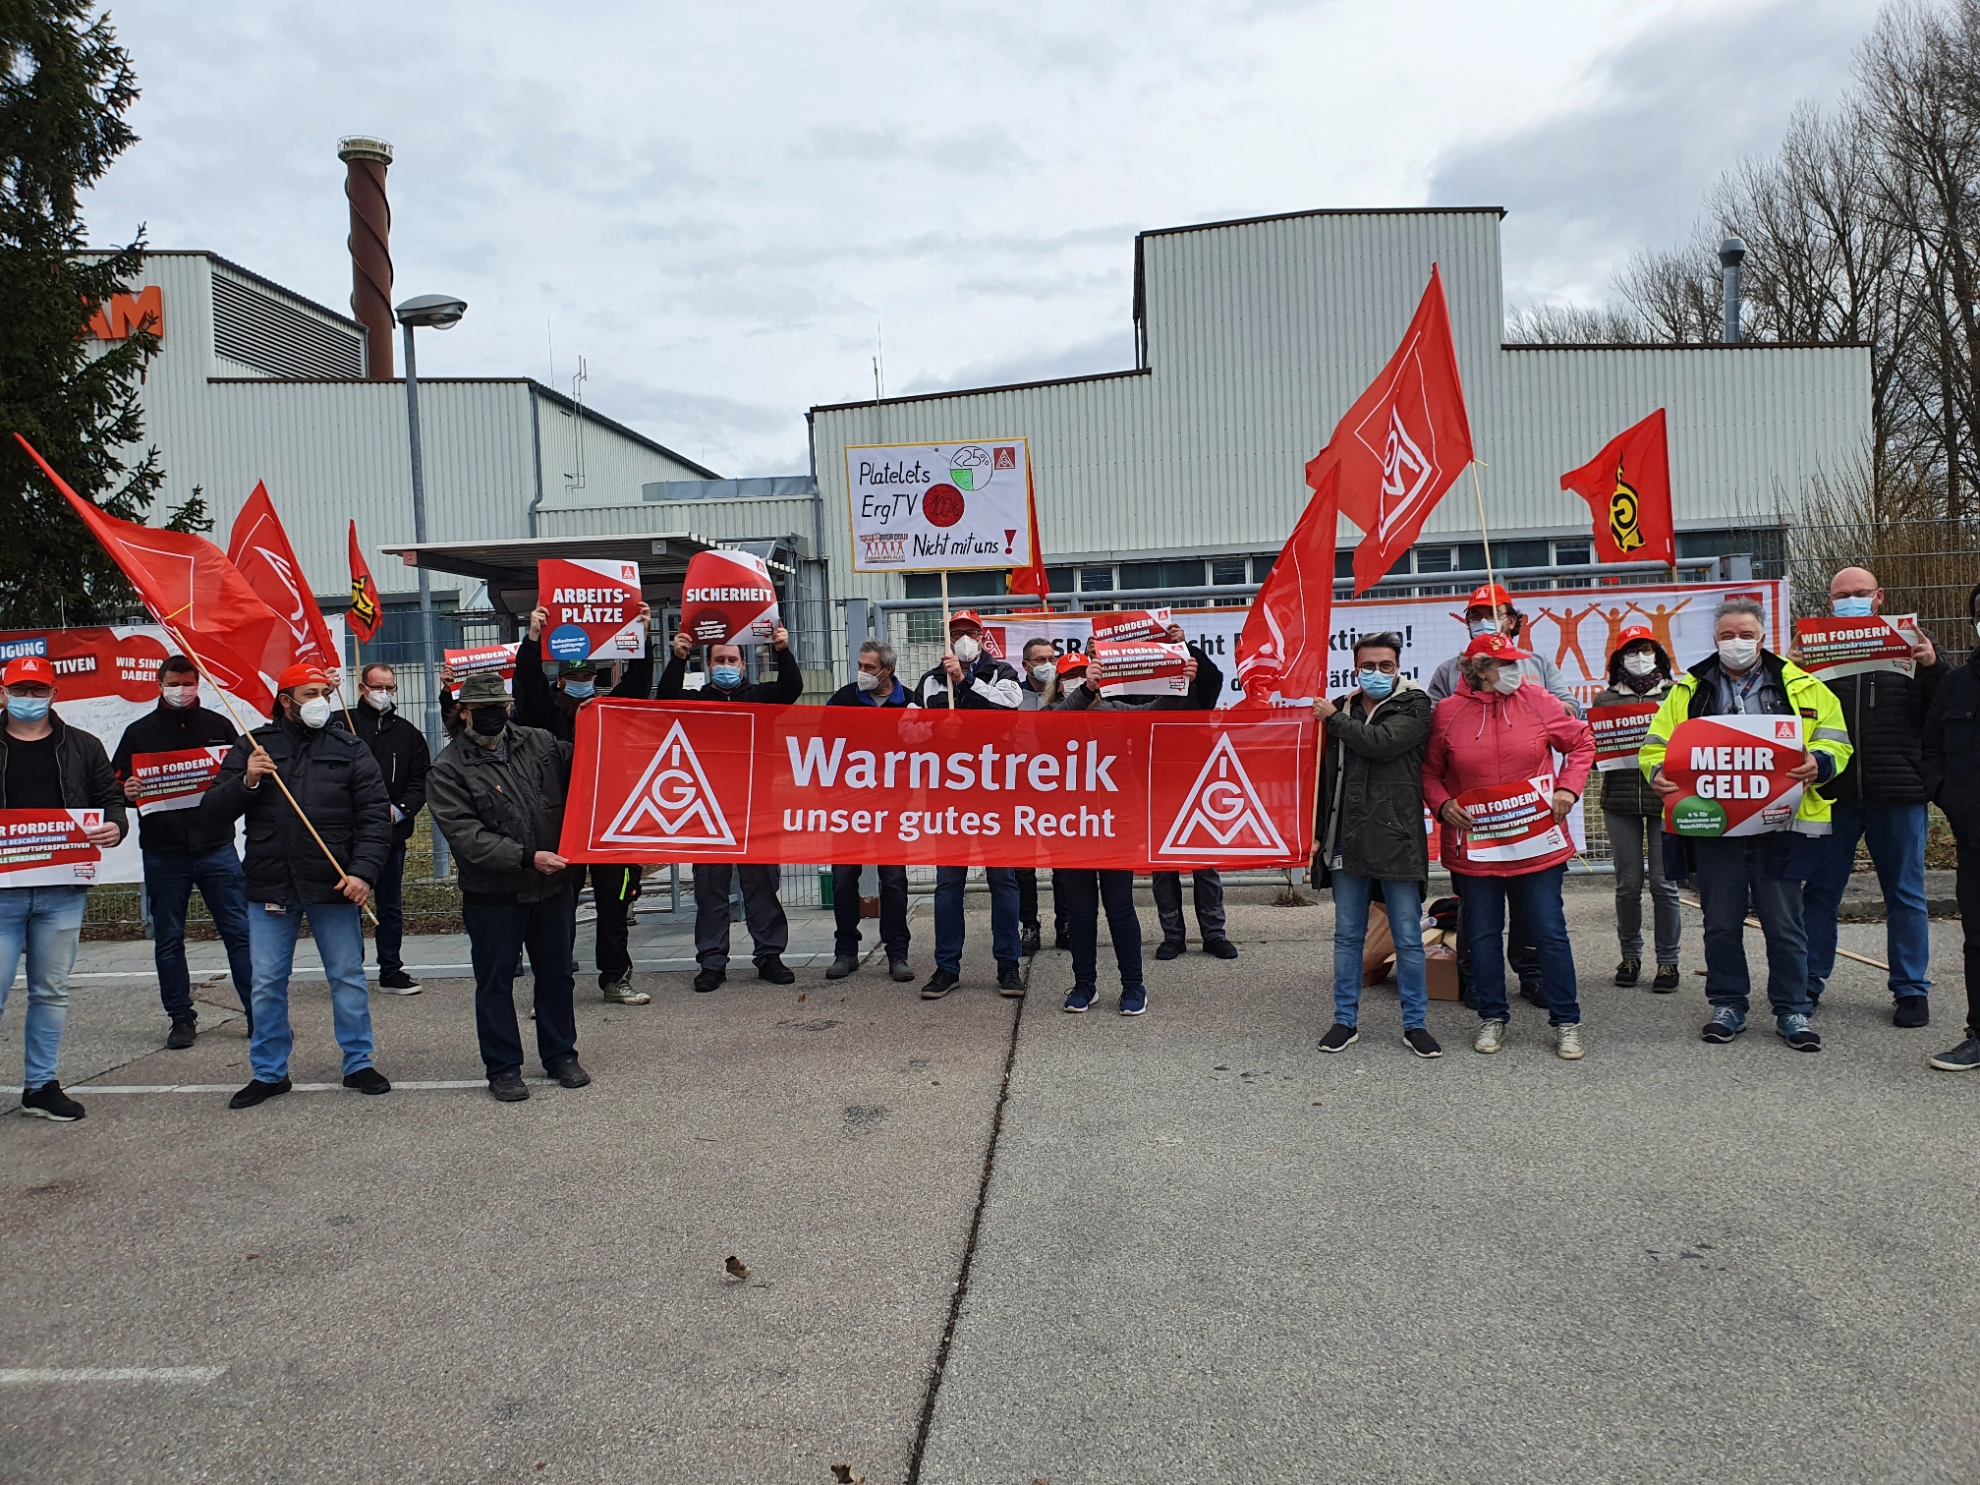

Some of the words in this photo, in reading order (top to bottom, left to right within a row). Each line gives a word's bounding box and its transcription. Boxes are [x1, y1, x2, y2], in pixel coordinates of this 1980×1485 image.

[859, 461, 931, 486] Platelets
[913, 533, 950, 557] Nicht
[951, 532, 975, 555] mit
[975, 540, 999, 554] uns
[552, 588, 631, 604] ARBEITS-
[686, 587, 772, 602] SICHERHEIT
[561, 604, 623, 623] PLÄTZE
[1096, 628, 1113, 638] WIR
[1114, 618, 1154, 634] FORDERN
[1801, 633, 1827, 644] WIR
[1829, 626, 1891, 642] FORDERN
[449, 656, 468, 664] WIR
[469, 650, 511, 661] FORDERN
[1099, 648, 1120, 657] WIR
[1121, 647, 1168, 656] FORDERN
[53, 657, 97, 674] TIVEN
[116, 656, 135, 668] WIR
[138, 658, 164, 669] SIND
[121, 669, 156, 681] DABEI!
[1592, 719, 1614, 730] WIR
[137, 766, 160, 777] WIR
[162, 757, 214, 774] FORDERN
[785, 736, 1119, 792] Warnstreik
[1691, 747, 1775, 771] MEHR
[1696, 775, 1771, 799] GELD
[1465, 804, 1487, 815] WIR
[1488, 791, 1540, 813] FORDERN
[10, 821, 75, 835] FORDERN
[783, 808, 889, 834] unser
[897, 805, 1001, 842] gutes
[1014, 805, 1116, 837] Recht
[3, 842, 90, 854] ZUKUNFTSPERSPEKTIVEN
[9, 835, 67, 846] BESCHÄFTIGUNG
